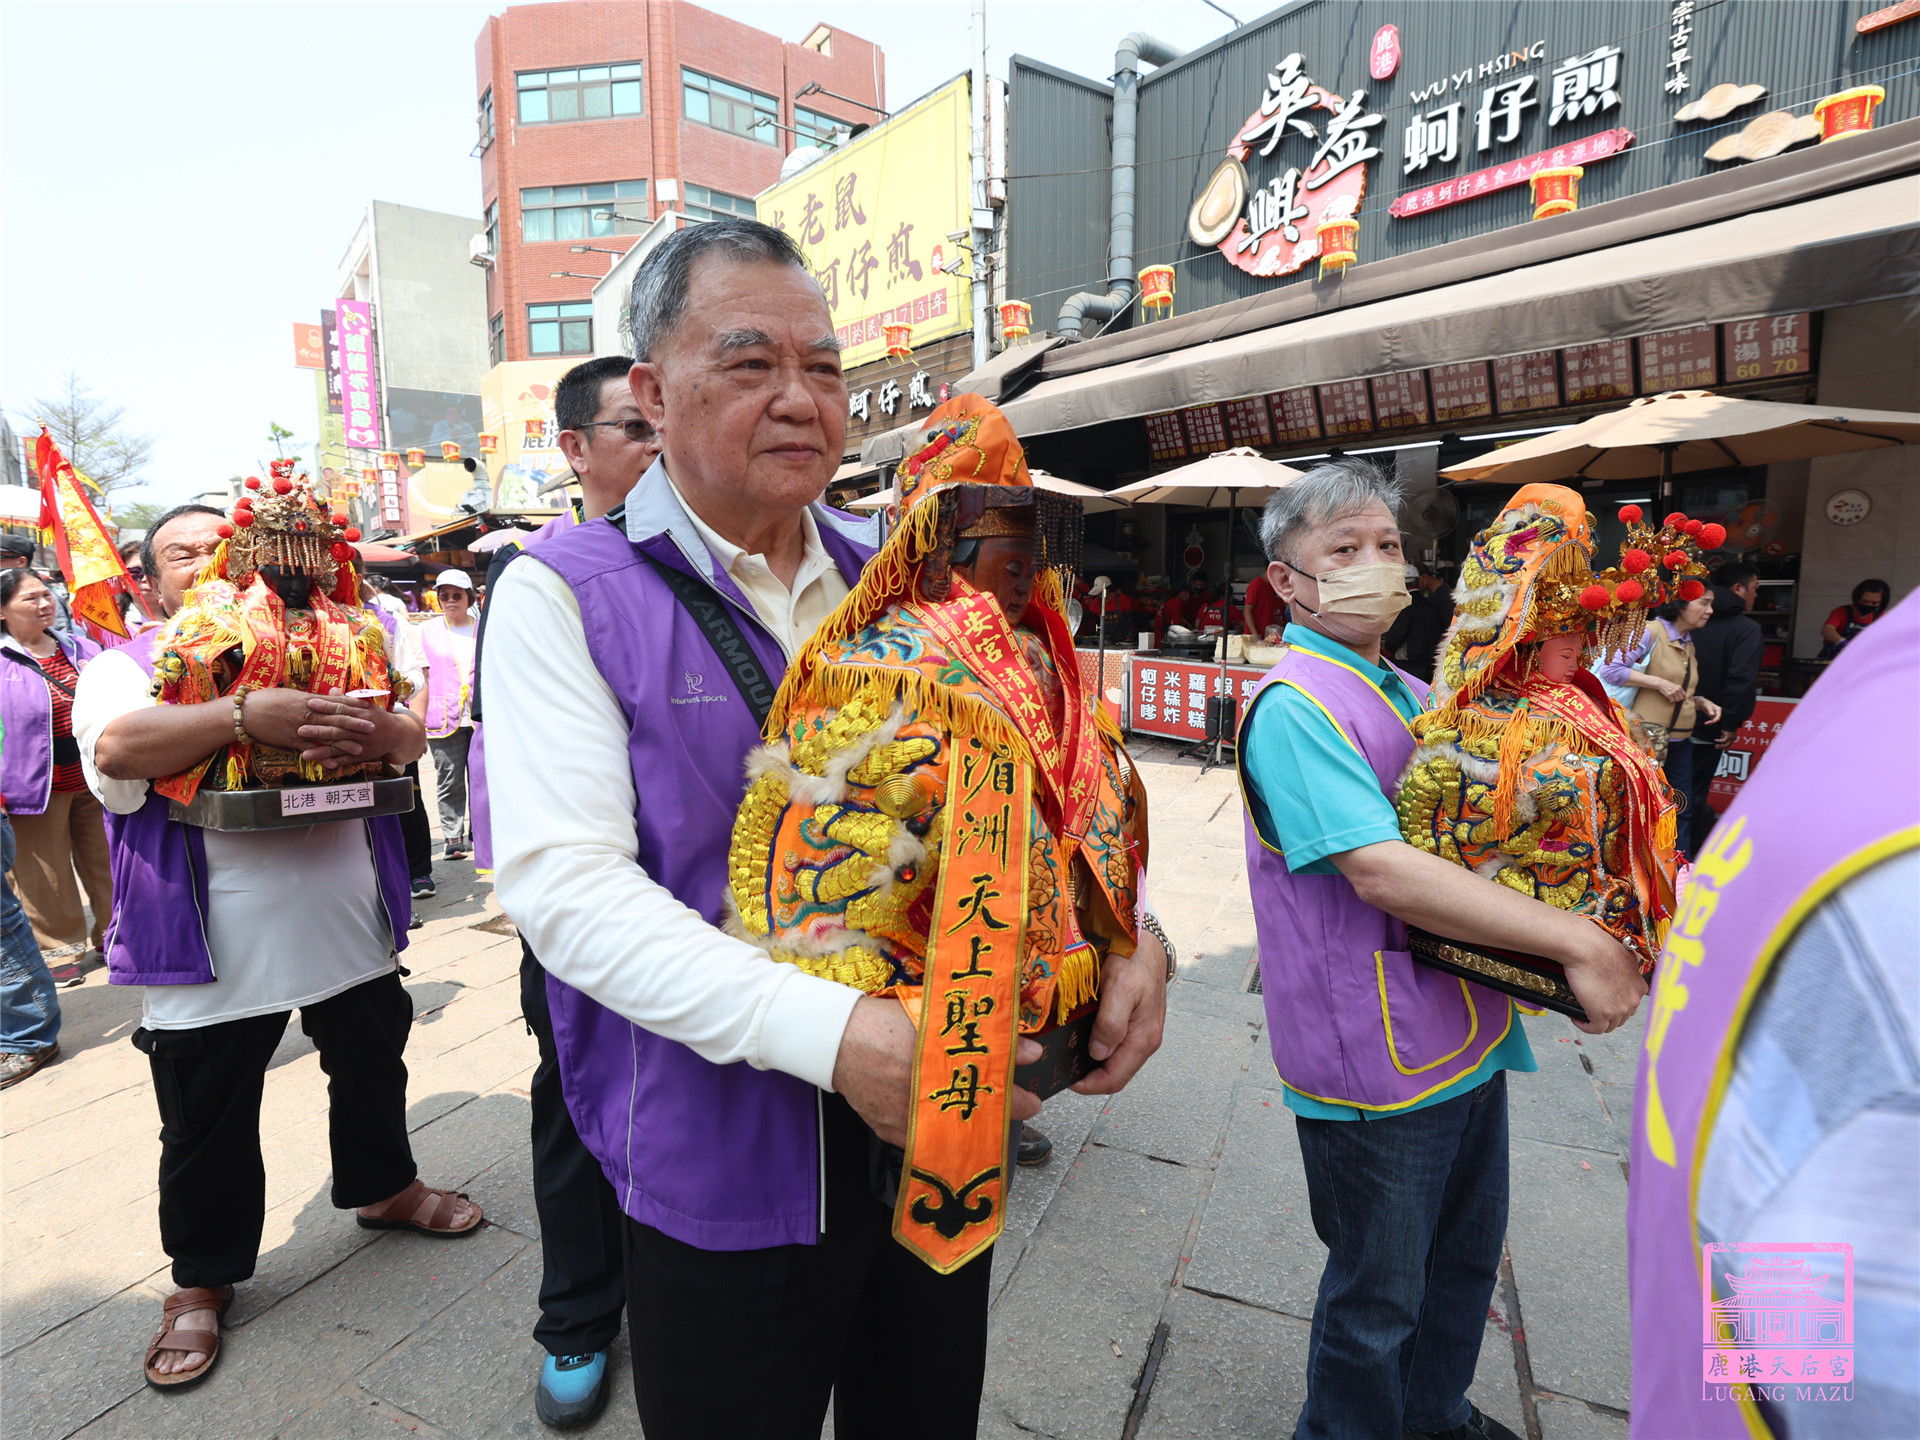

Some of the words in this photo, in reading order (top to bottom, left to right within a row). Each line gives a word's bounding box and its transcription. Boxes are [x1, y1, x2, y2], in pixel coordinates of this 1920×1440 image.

[1375, 29, 1394, 75] 鹿港
[1409, 78, 1449, 104] WU
[1452, 68, 1472, 90] YI
[1478, 40, 1546, 79] HSING
[1664, 1, 1695, 94] 宗古早味
[1403, 45, 1621, 176] 蚵仔煎
[1405, 136, 1610, 212] 鹿港蚵仔美食小吃發源地
[849, 371, 933, 422] 蚵仔煎
[1140, 667, 1158, 721] 蚵仔嗲
[1163, 671, 1182, 725] 米糕炸
[1187, 673, 1206, 729] 蘿蔔糕
[1213, 676, 1233, 698] 蝦
[284, 793, 316, 809] 北港
[325, 788, 371, 805] 朝天宮
